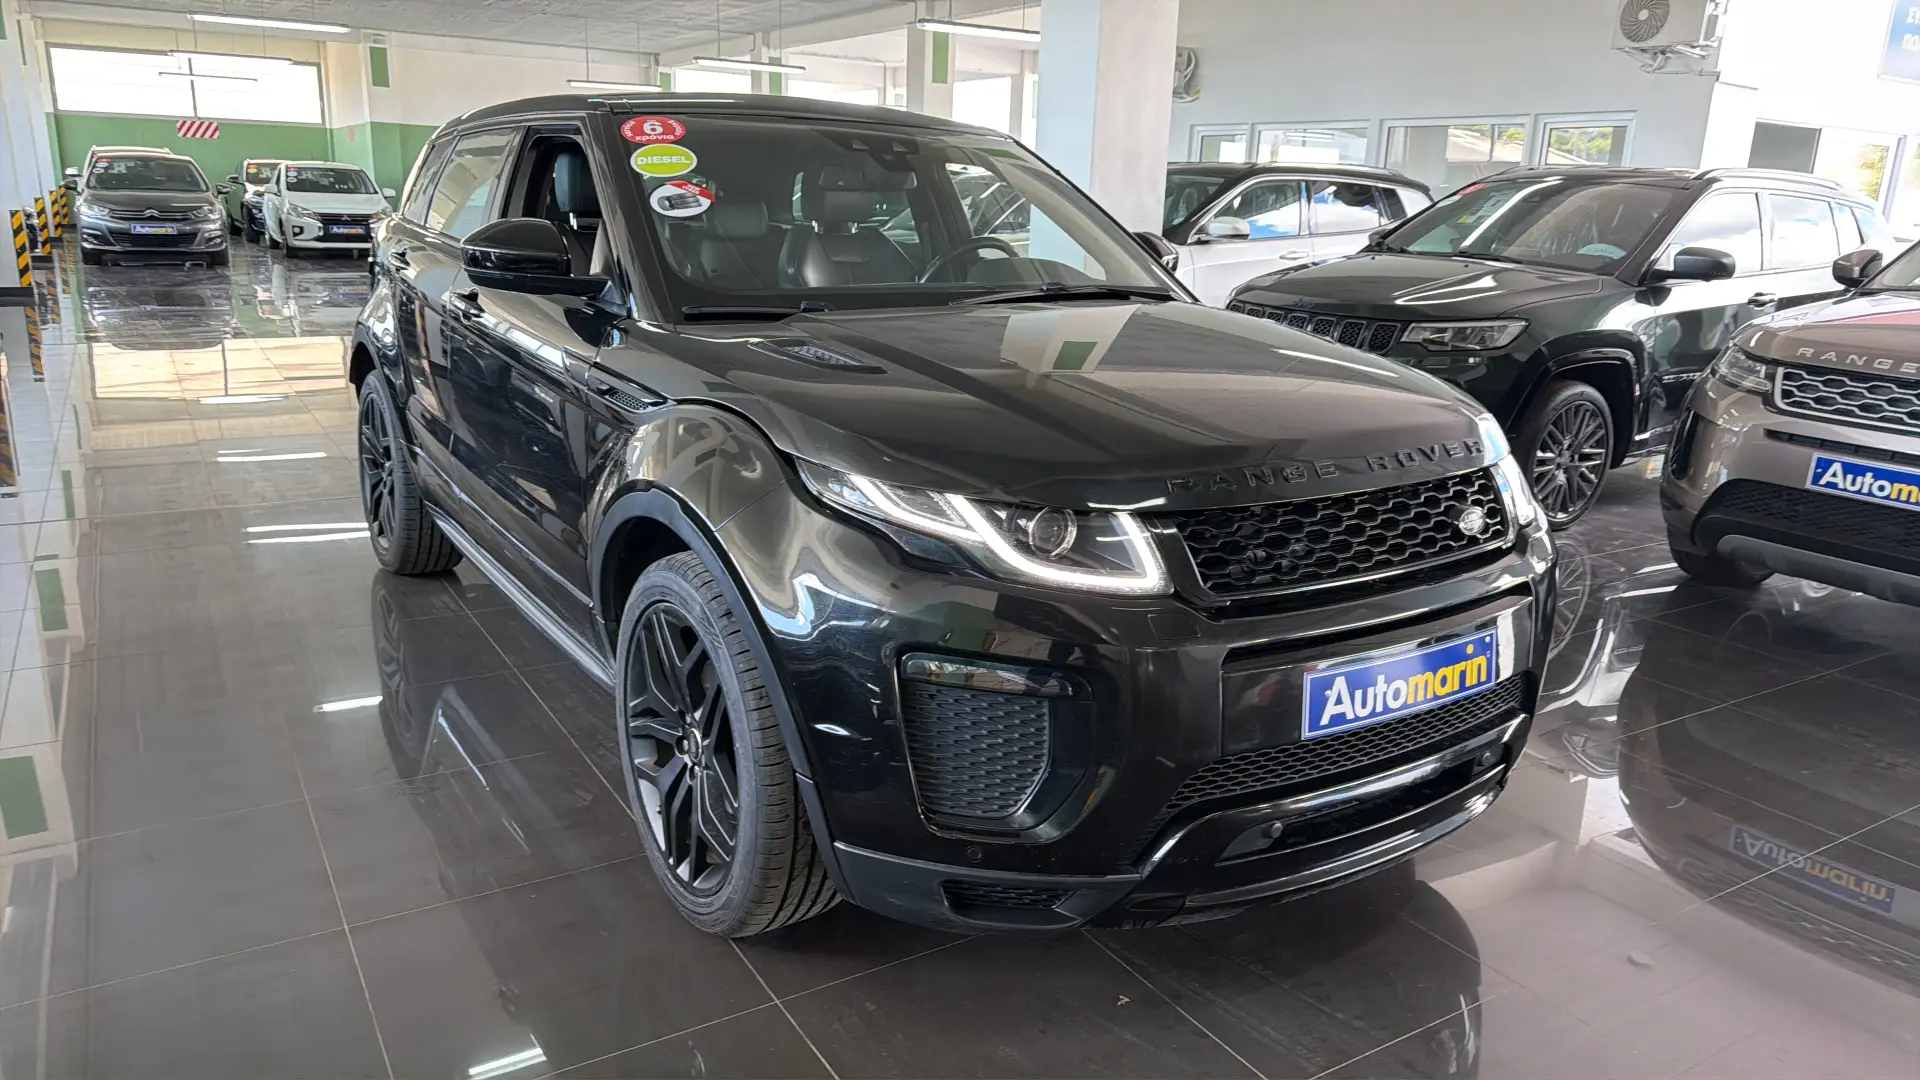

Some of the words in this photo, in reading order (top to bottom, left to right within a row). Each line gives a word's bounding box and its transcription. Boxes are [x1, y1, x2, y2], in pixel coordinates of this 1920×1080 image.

[634, 134, 675, 142] χρόνια
[643, 121, 664, 135] 6
[636, 155, 691, 165] DIESEL
[1796, 347, 1920, 374] RANGE
[1165, 461, 1340, 494] RANGE
[1364, 437, 1485, 472] ROVER
[1818, 461, 1920, 503] Autom
[1319, 643, 1489, 727] Automarin
